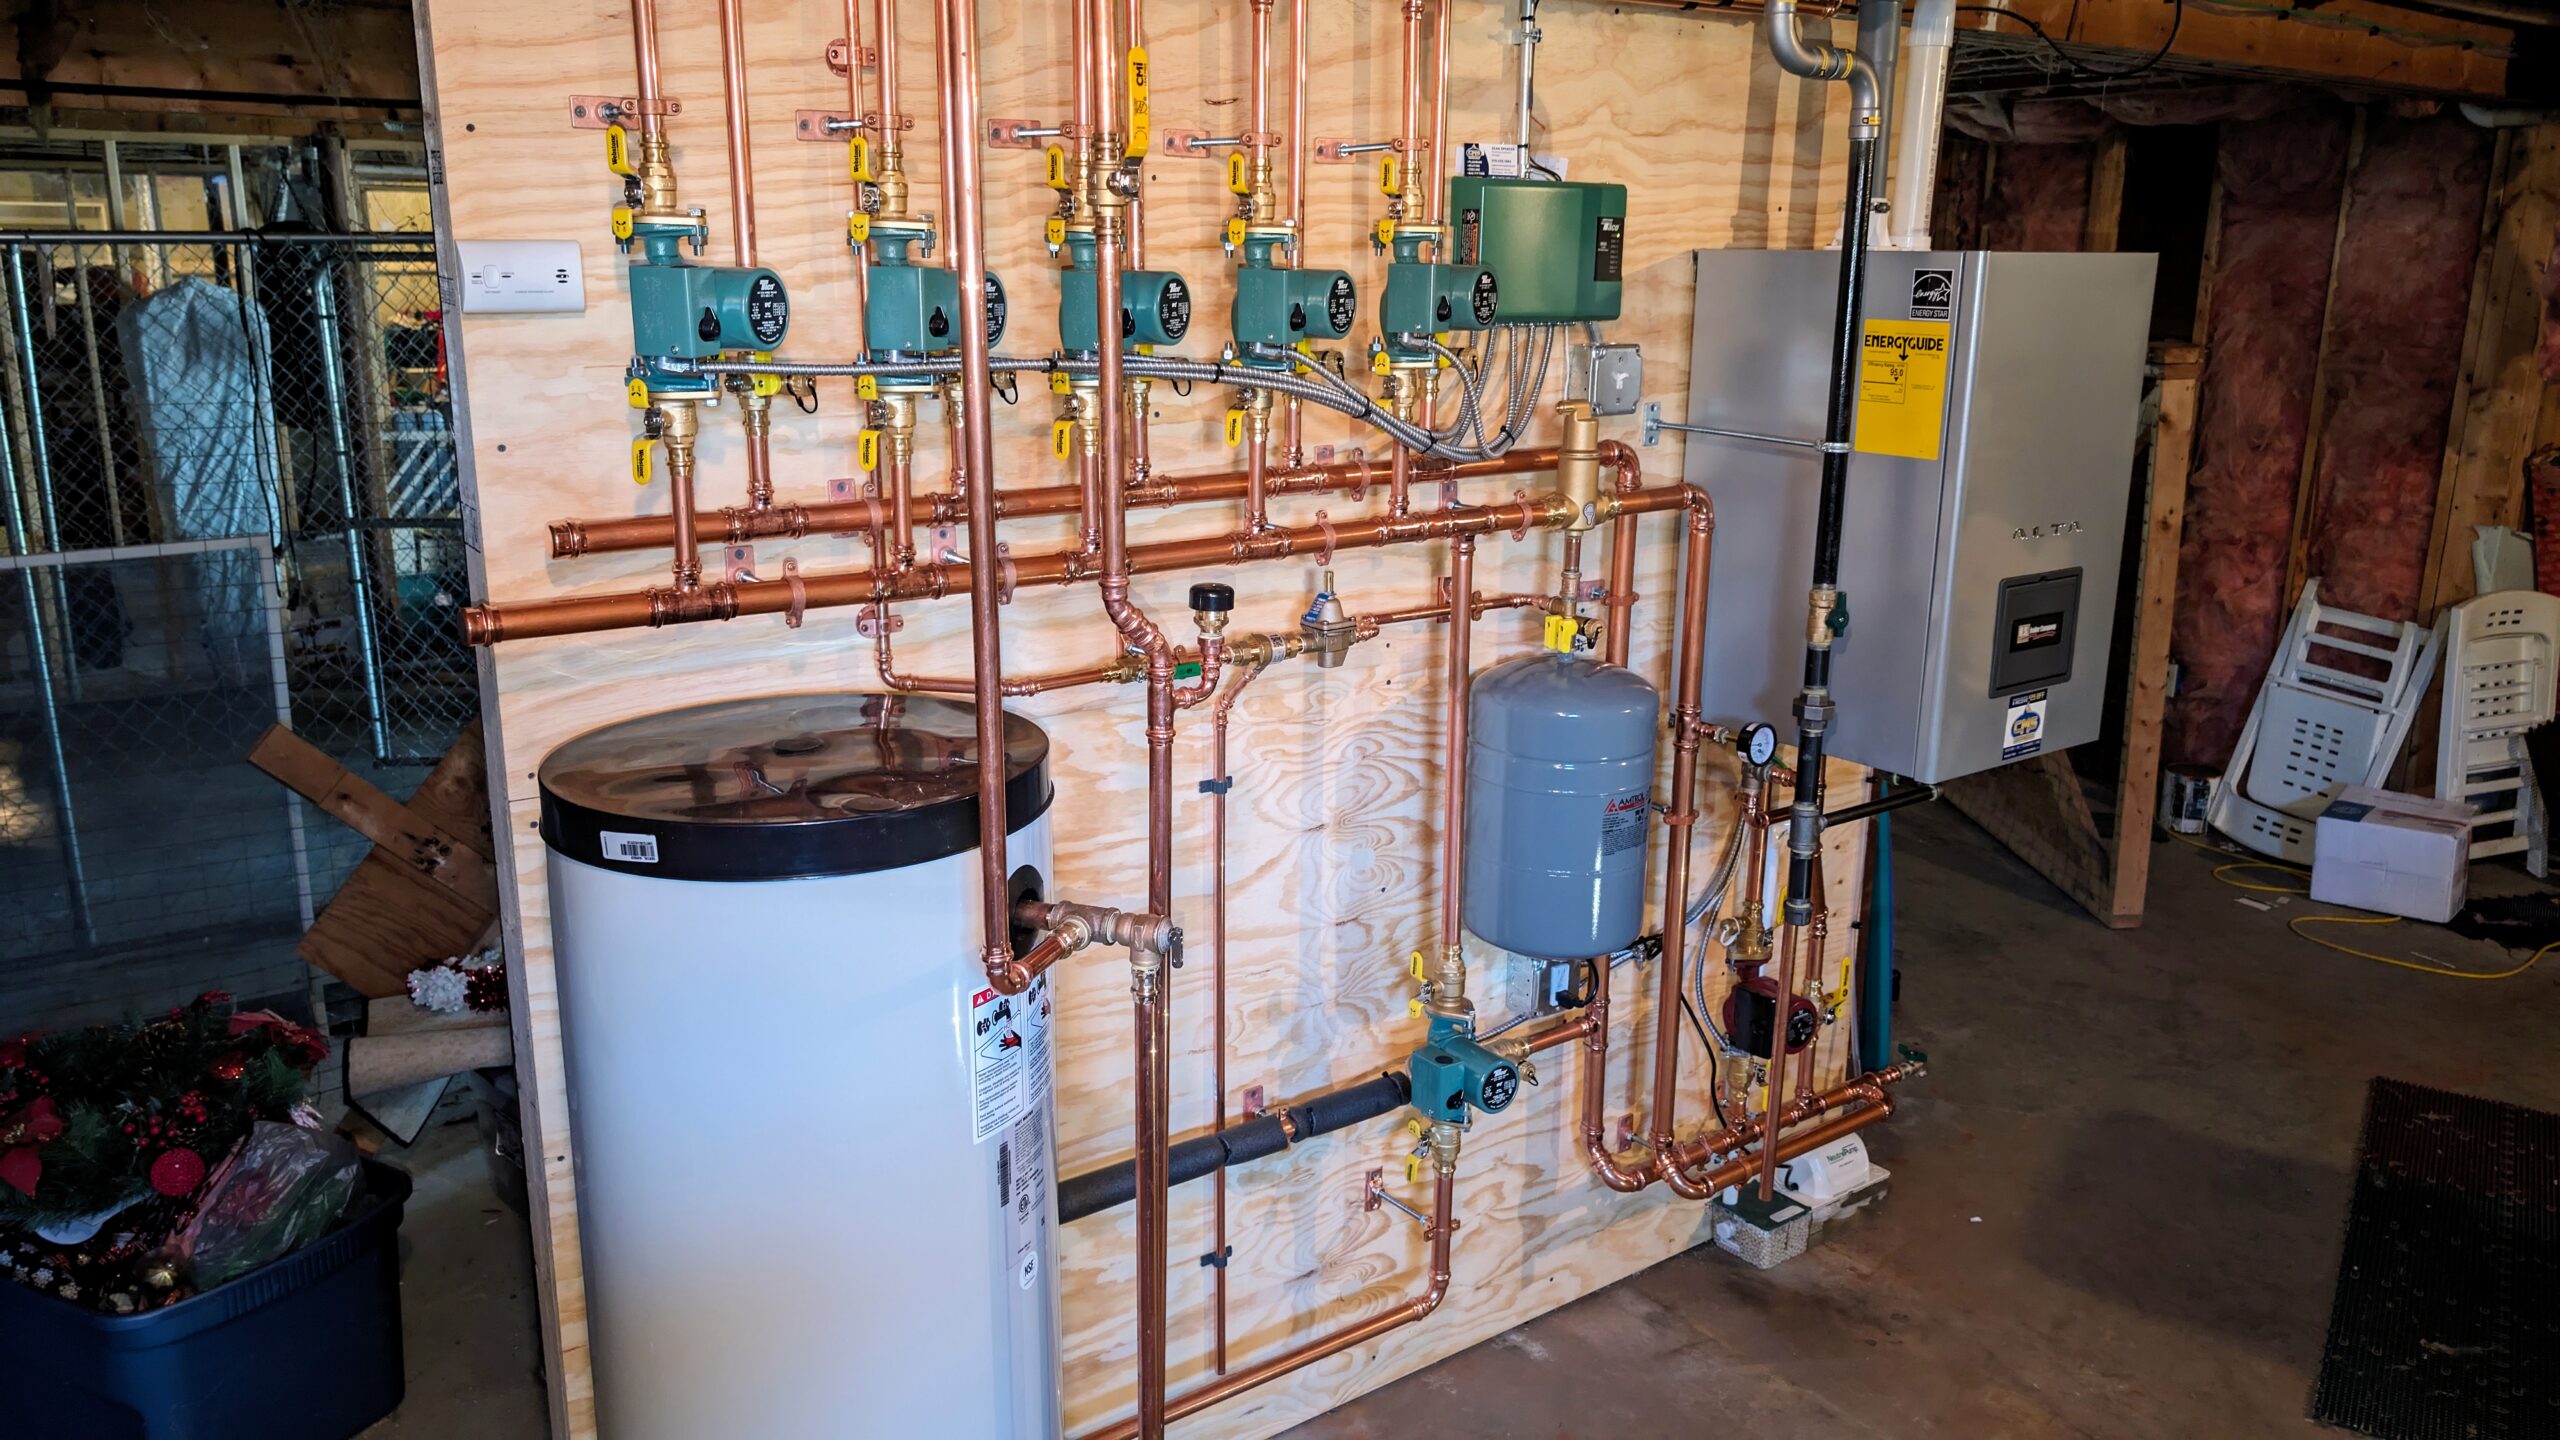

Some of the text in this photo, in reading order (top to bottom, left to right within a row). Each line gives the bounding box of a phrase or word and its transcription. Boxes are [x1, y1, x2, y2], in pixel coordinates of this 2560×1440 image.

[1601, 218, 1620, 231] Taco
[1911, 308, 1949, 318] ENERGY STAR
[1864, 334, 1945, 352] ENERGYGUIDE
[1890, 368, 1904, 377] 95.0
[2012, 520, 2083, 540] ALTA
[1618, 792, 1645, 806] AMTROL
[1024, 1258, 1036, 1277] NSF
